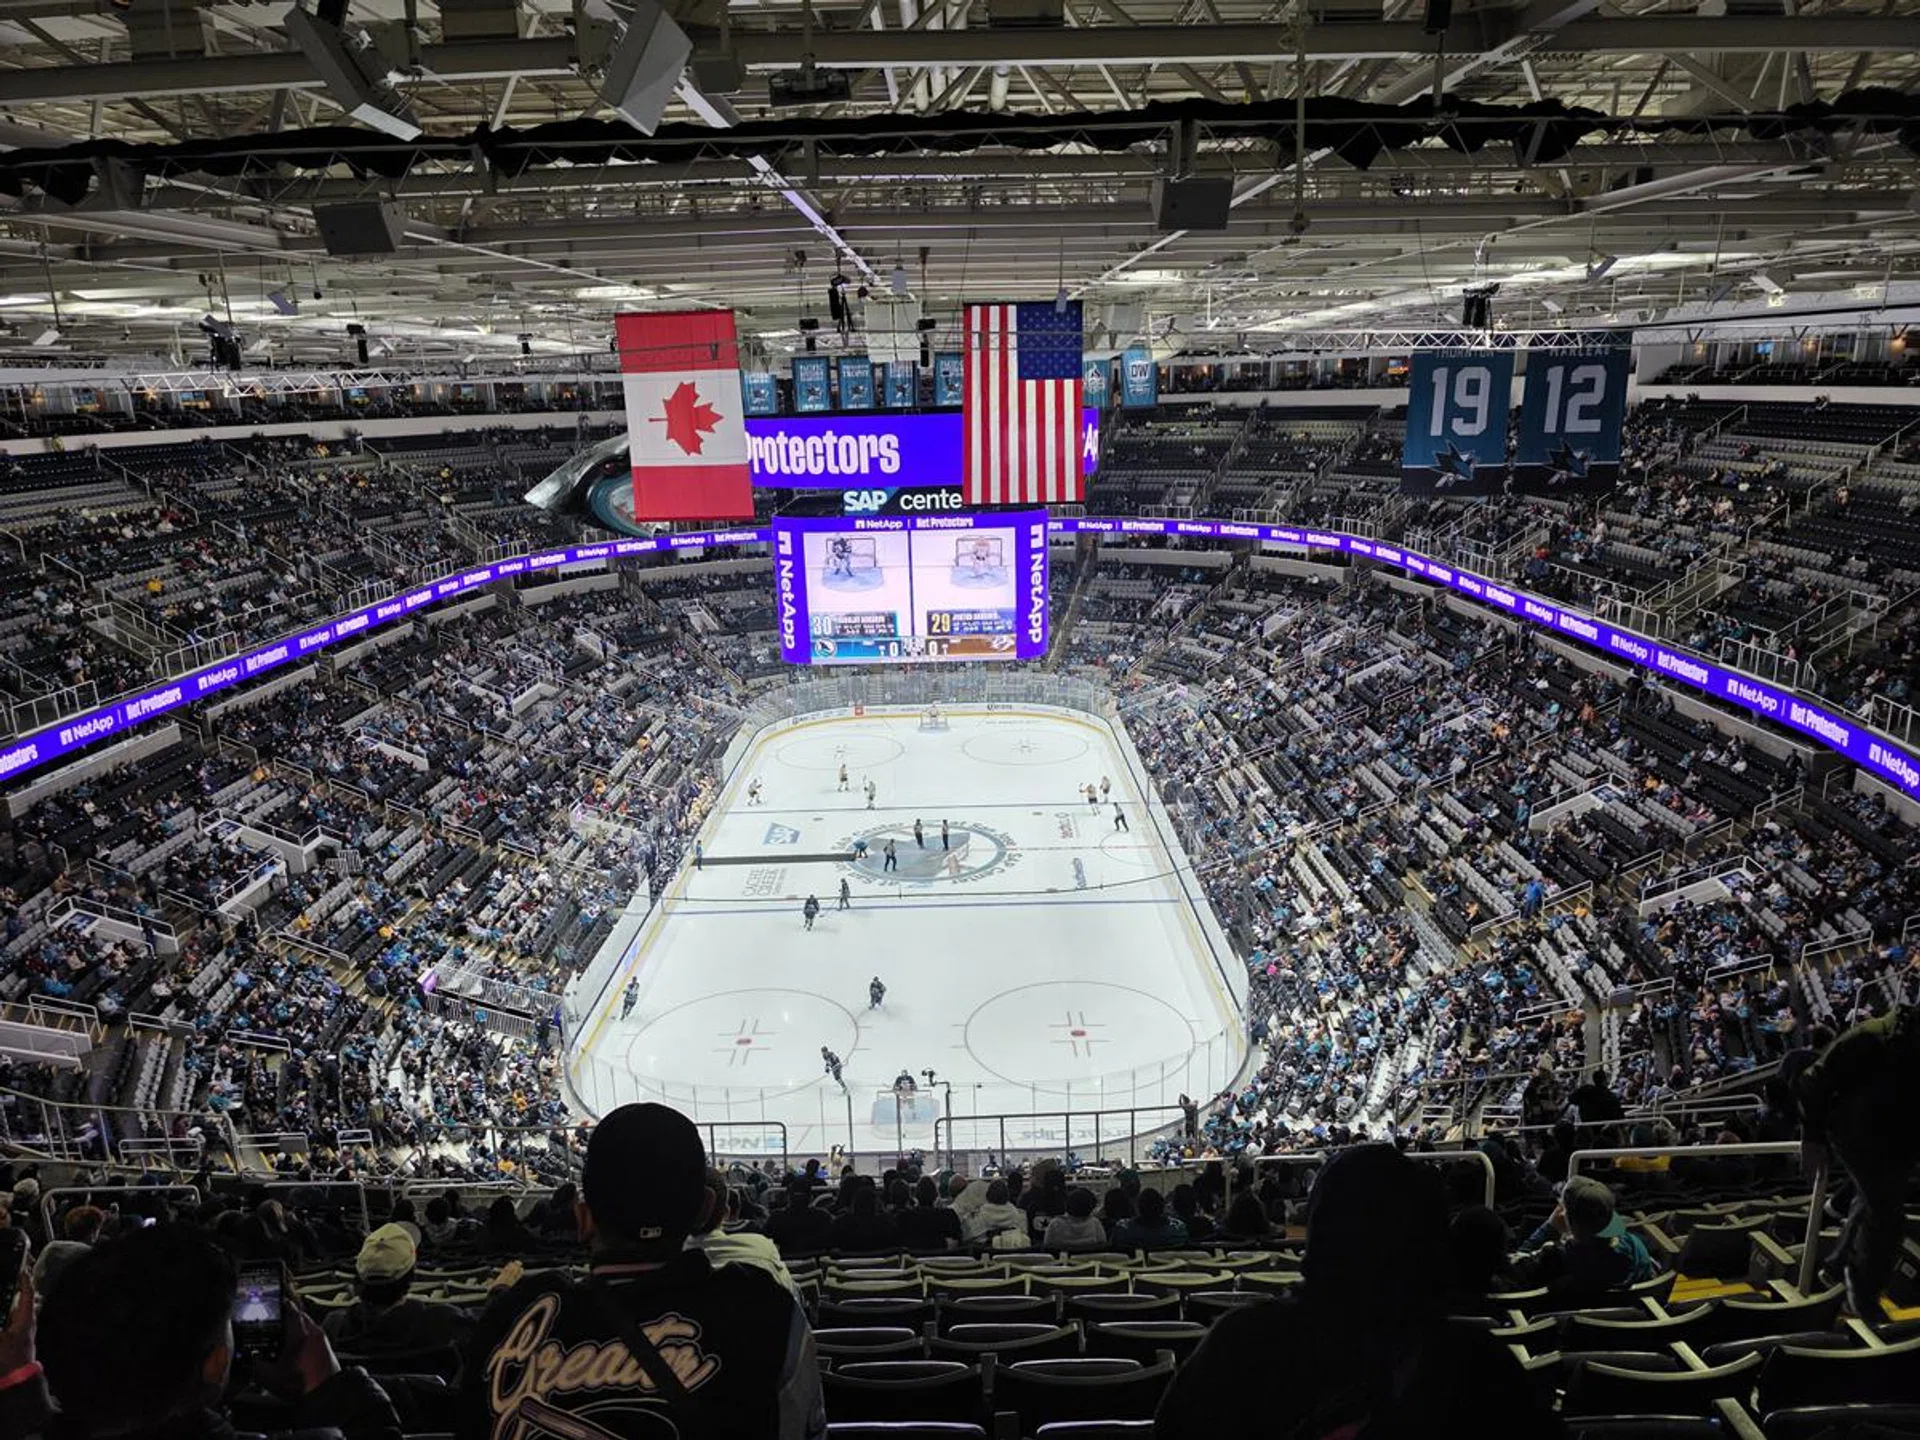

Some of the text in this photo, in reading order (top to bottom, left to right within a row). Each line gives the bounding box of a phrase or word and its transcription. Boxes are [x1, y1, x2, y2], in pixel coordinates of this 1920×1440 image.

[1131, 364, 1149, 378] DW
[1430, 366, 1491, 436] 19
[1544, 364, 1608, 434] 12
[843, 488, 962, 511] SAP cente
[866, 519, 903, 529] NetApp
[1086, 522, 1112, 530] NetApp
[678, 537, 705, 546] NetApp
[780, 560, 797, 649] NetApp
[1028, 553, 1045, 643] NetApp
[812, 615, 832, 635] 30
[931, 613, 950, 633] 29
[889, 641, 899, 656] 0
[928, 640, 938, 656] 0
[1620, 639, 1648, 658] NetApp
[208, 668, 238, 685] NetApp
[1740, 684, 1778, 711] NetApp
[74, 717, 114, 739] NetApp
[1882, 751, 1920, 786] NetApp
